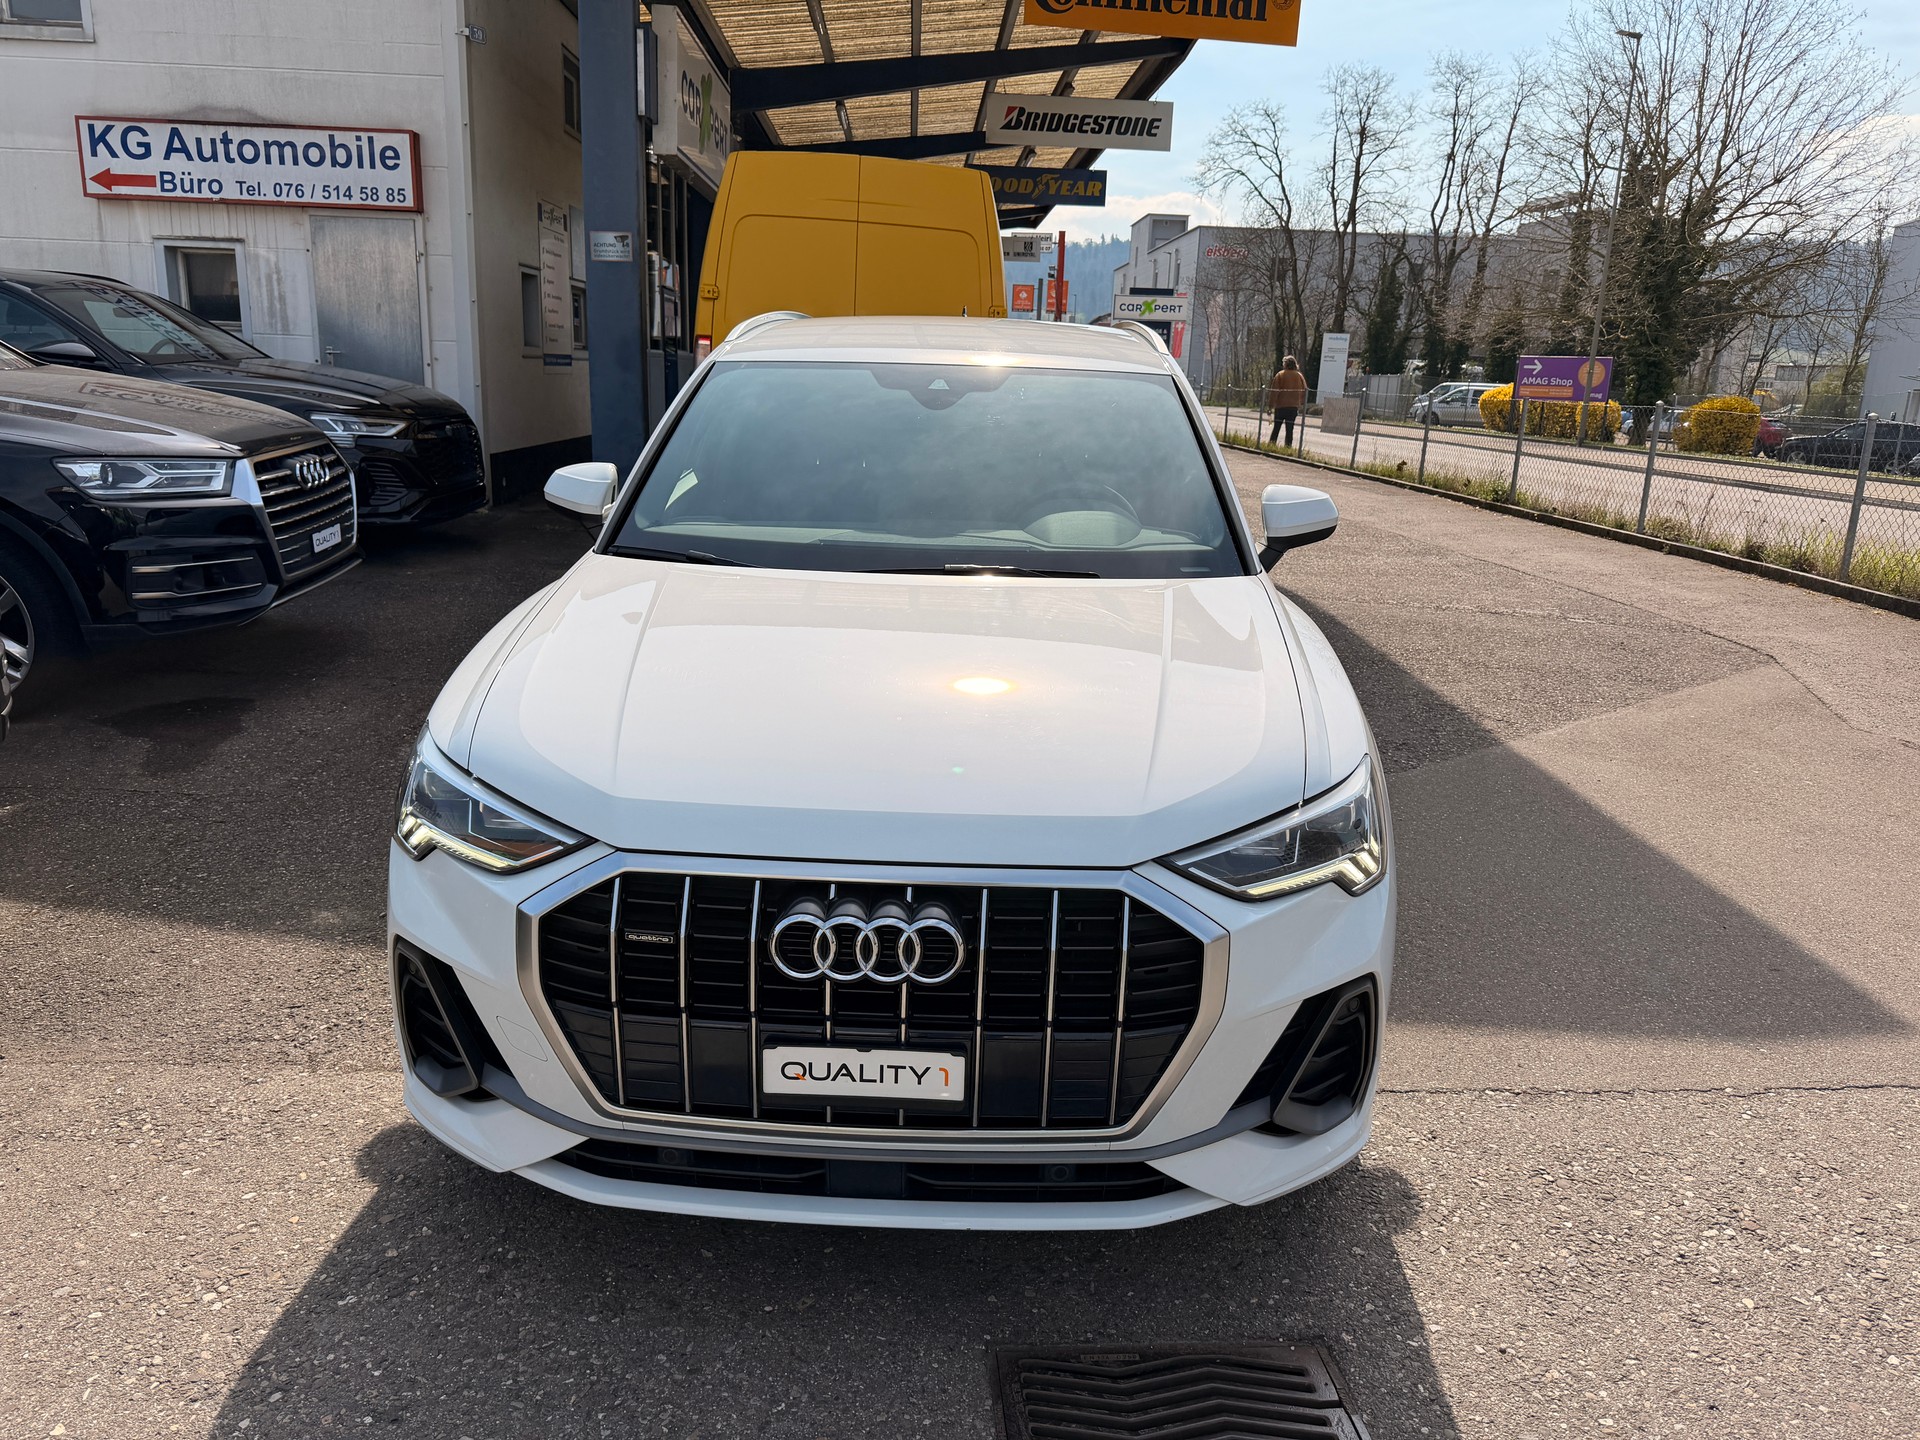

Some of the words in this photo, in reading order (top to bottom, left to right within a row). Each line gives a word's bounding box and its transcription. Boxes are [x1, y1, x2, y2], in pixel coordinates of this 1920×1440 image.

[1035, 0, 1267, 21] nental
[1000, 106, 1162, 137] BRIDGESTONE
[87, 123, 152, 160] KG
[163, 127, 400, 171] Automobile
[159, 171, 223, 195] Büro
[235, 181, 267, 197] Tel.
[273, 182, 305, 198] 076
[310, 184, 316, 199] /
[322, 185, 353, 200] 514
[359, 186, 379, 202] 58
[386, 188, 406, 203] 85
[991, 175, 1102, 197] OODYEAR
[1521, 377, 1548, 385] AMAG
[1550, 378, 1573, 387] Shop
[315, 532, 336, 546] QUALITY
[628, 934, 669, 942] quattro
[780, 1061, 931, 1085] QUALITY
[938, 1067, 949, 1087] 1
